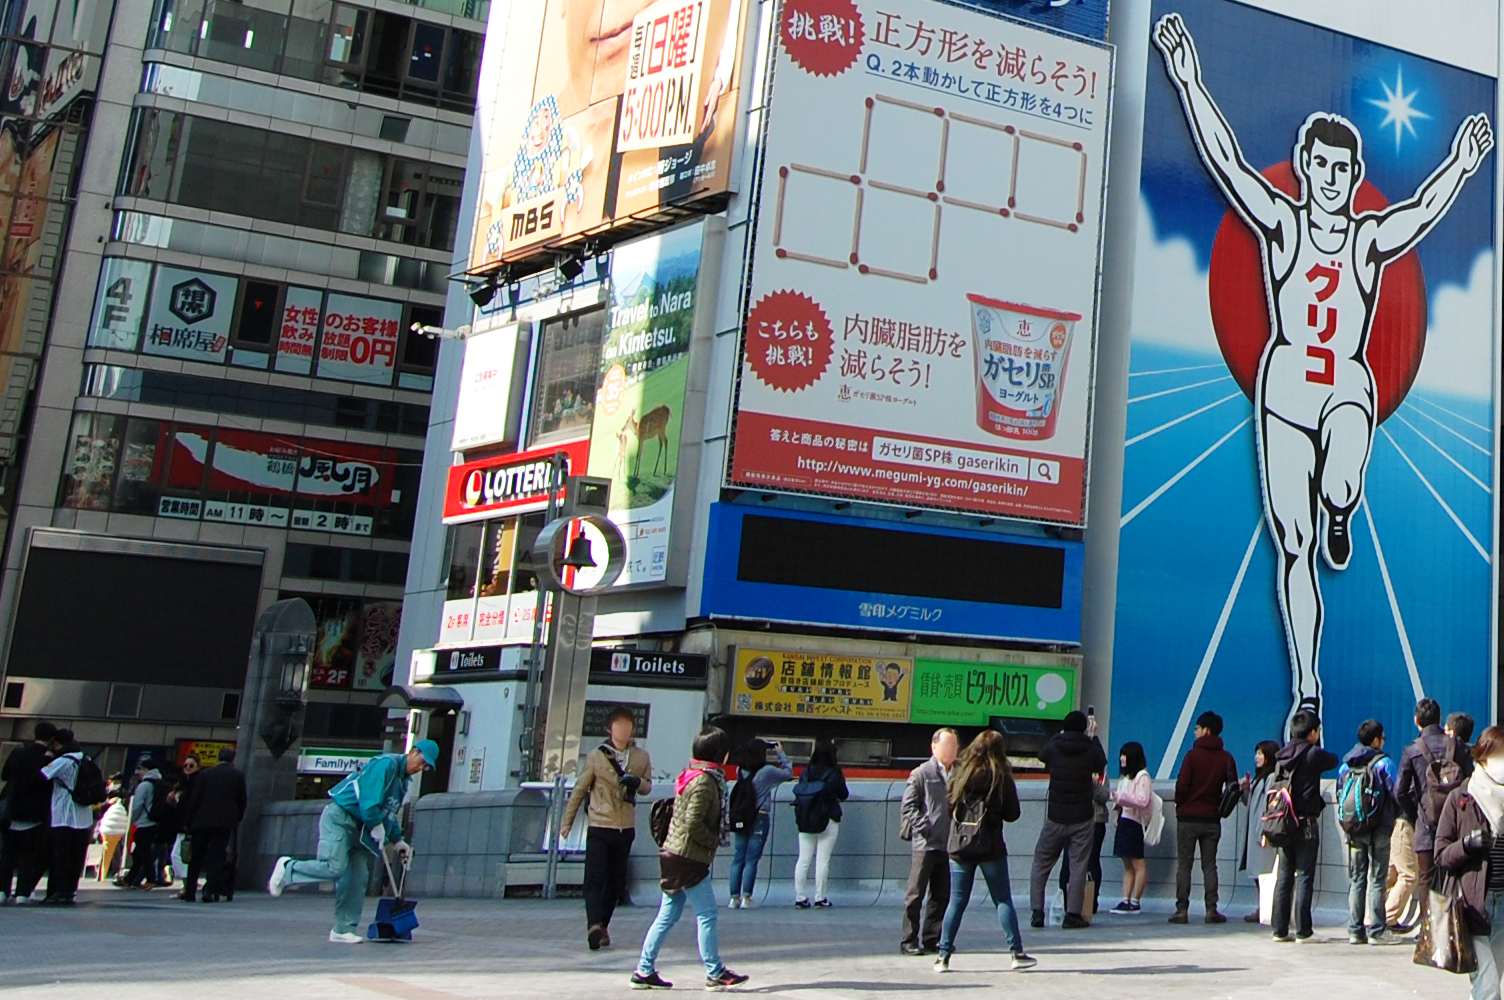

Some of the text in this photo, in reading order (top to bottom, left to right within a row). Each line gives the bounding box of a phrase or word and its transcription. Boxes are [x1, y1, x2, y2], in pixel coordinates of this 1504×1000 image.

[787, 8, 856, 46] 挑戦!
[869, 9, 1097, 100] 正方形を減らそう!
[103, 276, 133, 330] 4F
[610, 290, 692, 329] Travel to Nara
[280, 323, 351, 348] 飲み放題
[284, 304, 399, 338] 女性のお客様
[757, 319, 820, 343] こちらも
[843, 312, 968, 360] 内臓脂肪を
[1016, 319, 1034, 338] 恵
[1304, 259, 1343, 387] グリコ
[150, 323, 218, 354] 相席屋
[350, 335, 396, 369] 0円
[605, 326, 677, 360] on Kintetsu.
[764, 341, 814, 368] 挑戦!
[839, 347, 932, 391] 減らそう!
[983, 352, 1041, 388] ガセリ
[999, 387, 1040, 405] ヨーグルト
[769, 427, 1019, 477] 答えと商品の秘密は ガセリ菌SP株 gaserikin
[797, 455, 1029, 498] http://www.megumi-yg.com/gaserikin/
[160, 499, 200, 517] 営業時間
[857, 602, 943, 623] 雪印メグミルク
[327, 669, 348, 684] 2F
[633, 657, 686, 675] Toilets
[780, 660, 872, 681] 店舗情報館
[965, 669, 1030, 708] ピタットハウス
[314, 756, 367, 772] FamilyMa
